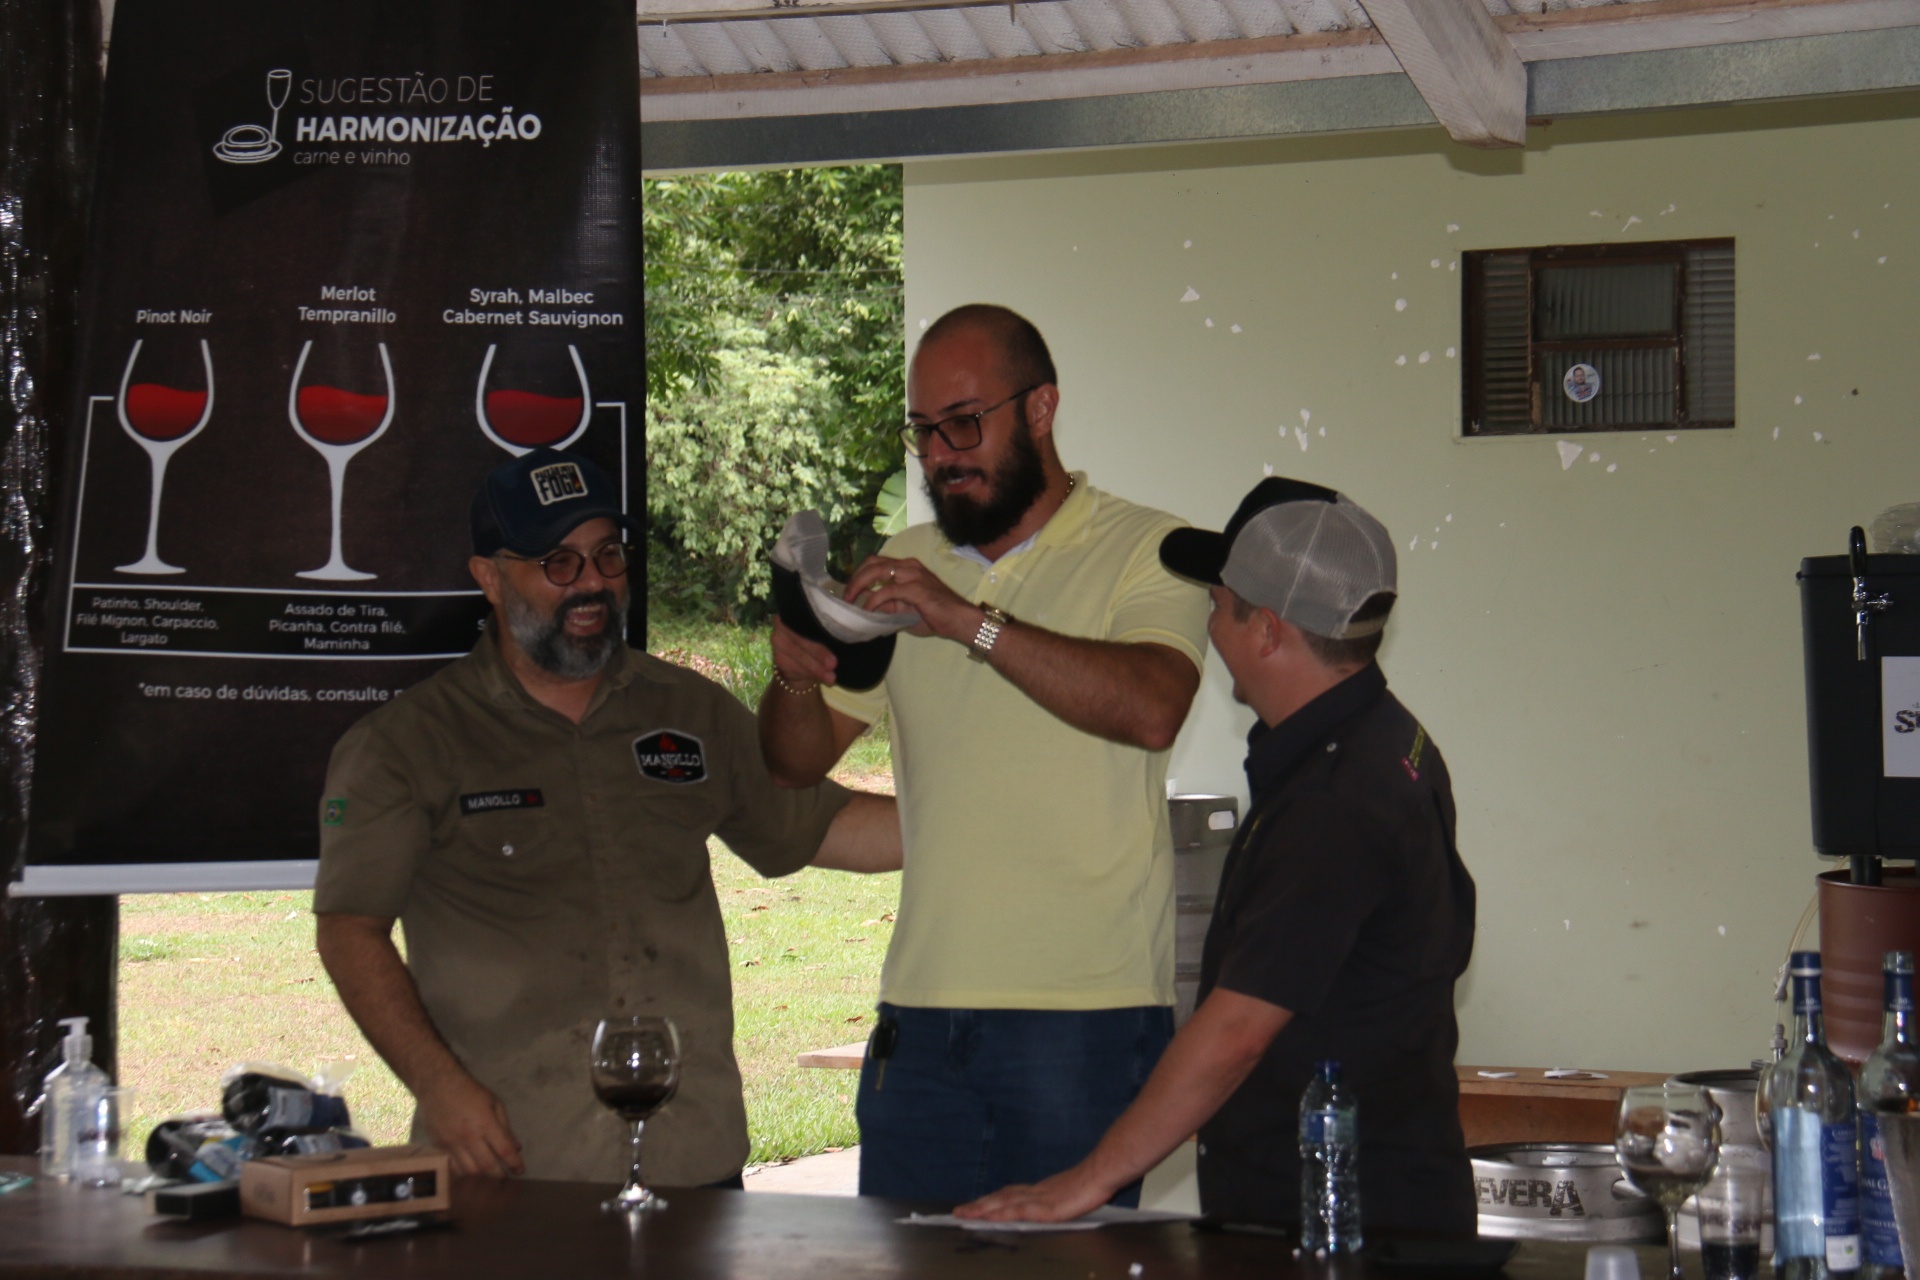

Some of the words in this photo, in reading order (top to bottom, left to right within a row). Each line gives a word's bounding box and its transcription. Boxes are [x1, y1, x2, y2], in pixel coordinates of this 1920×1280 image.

[299, 72, 448, 104] SUGESTÃO
[457, 75, 494, 102] DE
[296, 106, 542, 147] HARMONIZAÇÃO
[293, 151, 340, 165] carne
[344, 151, 356, 164] e
[361, 148, 411, 165] vinho
[321, 286, 376, 301] Merlot
[470, 287, 523, 306] Syrah,
[528, 289, 594, 304] Malbec
[136, 309, 175, 323] Pinot
[180, 309, 213, 323] Noir
[298, 306, 397, 324] Tempranillo
[442, 309, 523, 325] Cabernet
[528, 310, 623, 328] Sauvignon
[284, 603, 333, 616] Assado
[337, 605, 356, 616] de
[76, 612, 98, 625] Filé
[330, 621, 377, 633] Contra
[121, 632, 168, 646] Largato
[304, 637, 370, 650] Maminha
[175, 686, 212, 699] caso
[216, 684, 238, 699] de
[316, 686, 389, 701] consulte
[640, 753, 700, 769] MANOLLO
[468, 793, 521, 809] MANOLLO
